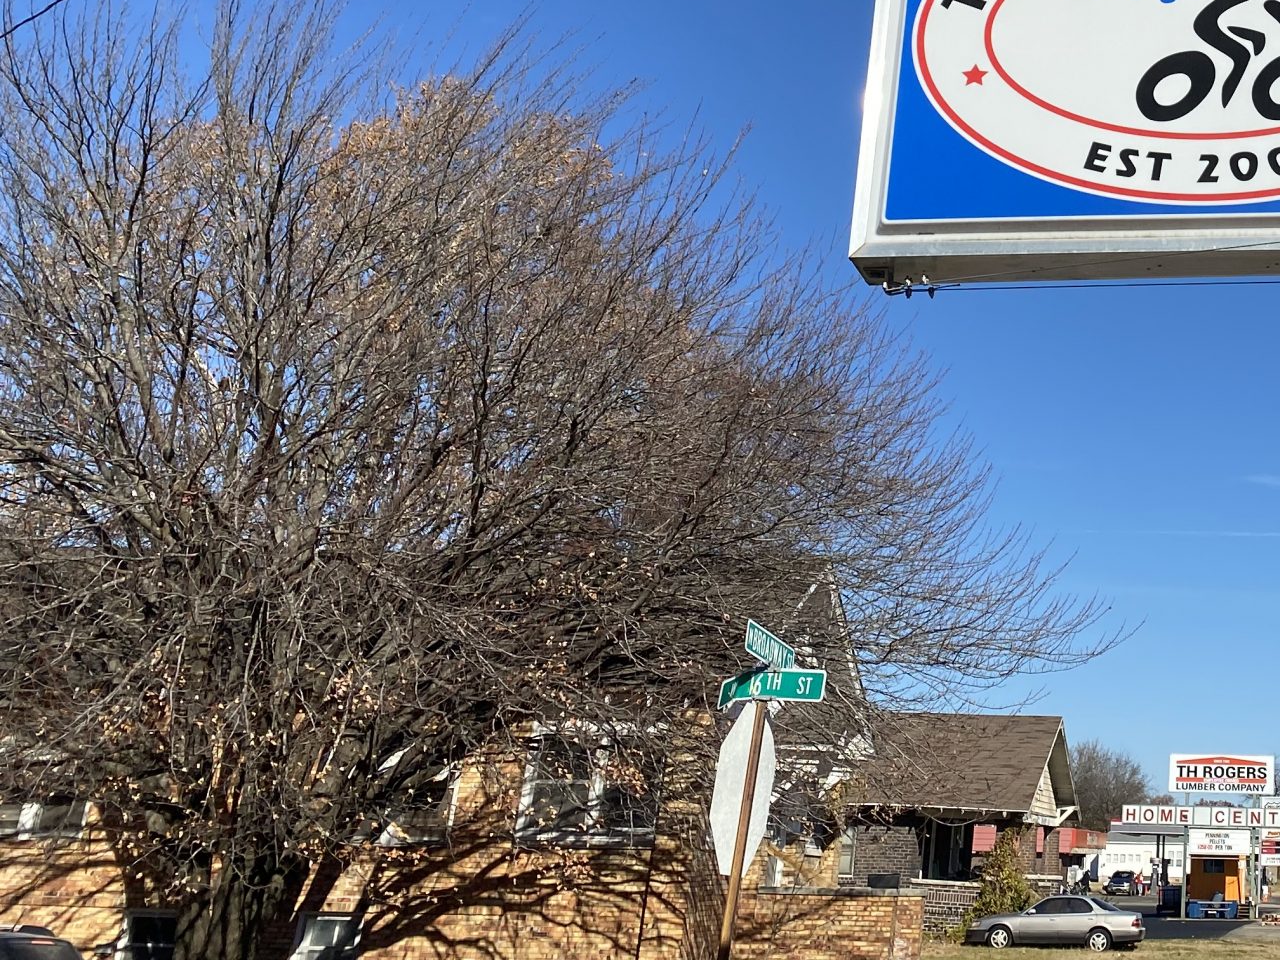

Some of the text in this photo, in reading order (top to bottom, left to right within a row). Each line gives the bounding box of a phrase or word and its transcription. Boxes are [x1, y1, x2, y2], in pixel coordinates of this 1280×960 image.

[1083, 141, 1173, 181] EST
[752, 628, 788, 668] BROADWAY
[749, 672, 782, 695] 16TH
[796, 677, 814, 694] ST
[1177, 765, 1267, 779] TH ROGERS
[1176, 782, 1266, 792] LUMBER COMPANY
[1125, 808, 1189, 822] HOME
